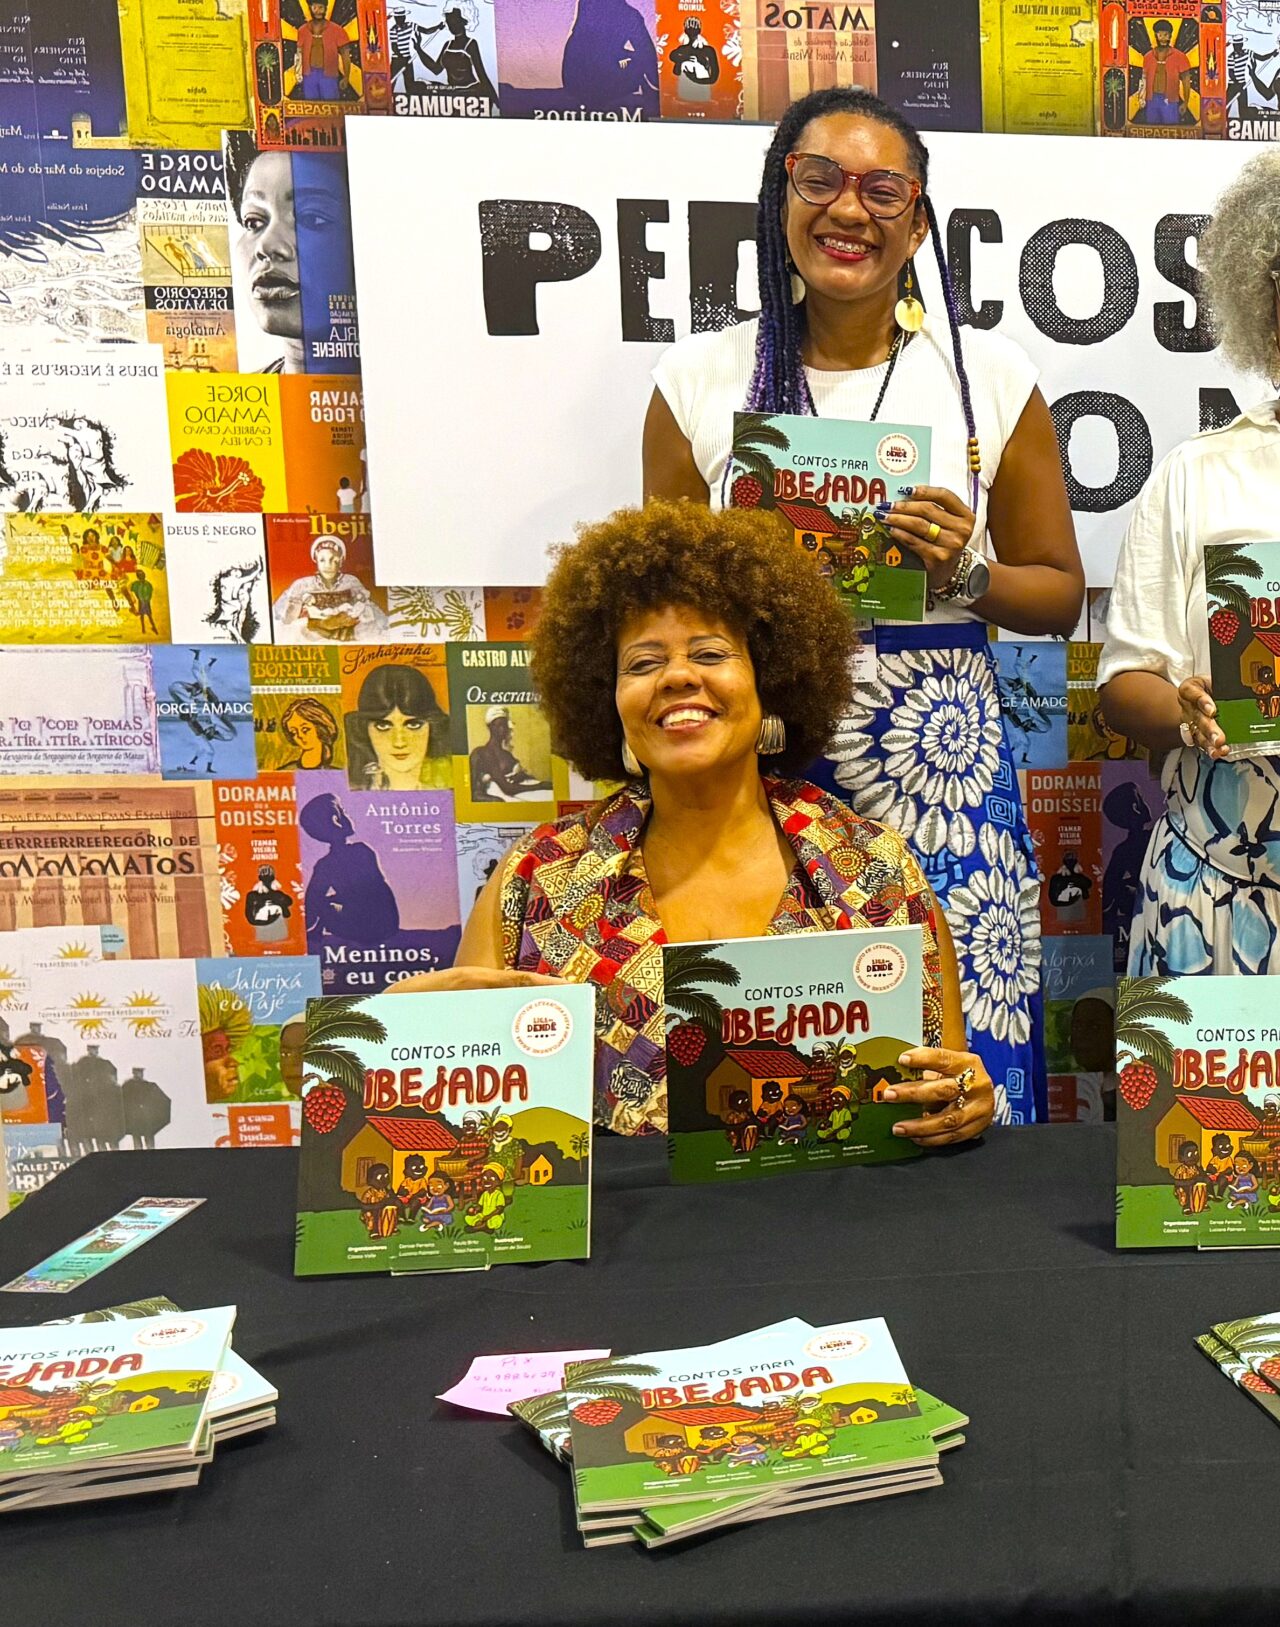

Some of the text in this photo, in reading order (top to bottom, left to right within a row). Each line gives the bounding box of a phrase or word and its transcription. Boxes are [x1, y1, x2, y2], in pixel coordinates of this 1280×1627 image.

[792, 454, 869, 471] CONTOS PARA
[167, 523, 257, 536] DEUS É NEGRO
[462, 650, 508, 668] CASTRO
[467, 685, 488, 703] Os
[156, 702, 200, 715] JORGE
[366, 802, 441, 818] Antônio
[381, 820, 441, 835] Torres
[180, 835, 198, 847] DE
[325, 943, 439, 965] Meninos,
[346, 970, 376, 985] eu
[210, 979, 221, 992] a
[745, 981, 845, 1001] CONTOS PARA
[246, 990, 286, 1018] Pajé
[1196, 1028, 1255, 1043] CONTOS
[391, 1042, 501, 1061] CONTOS PARA
[247, 1114, 276, 1123] casa
[238, 1122, 261, 1132] dos
[67, 1345, 115, 1357] PARA
[669, 1370, 745, 1383] CONTOS
